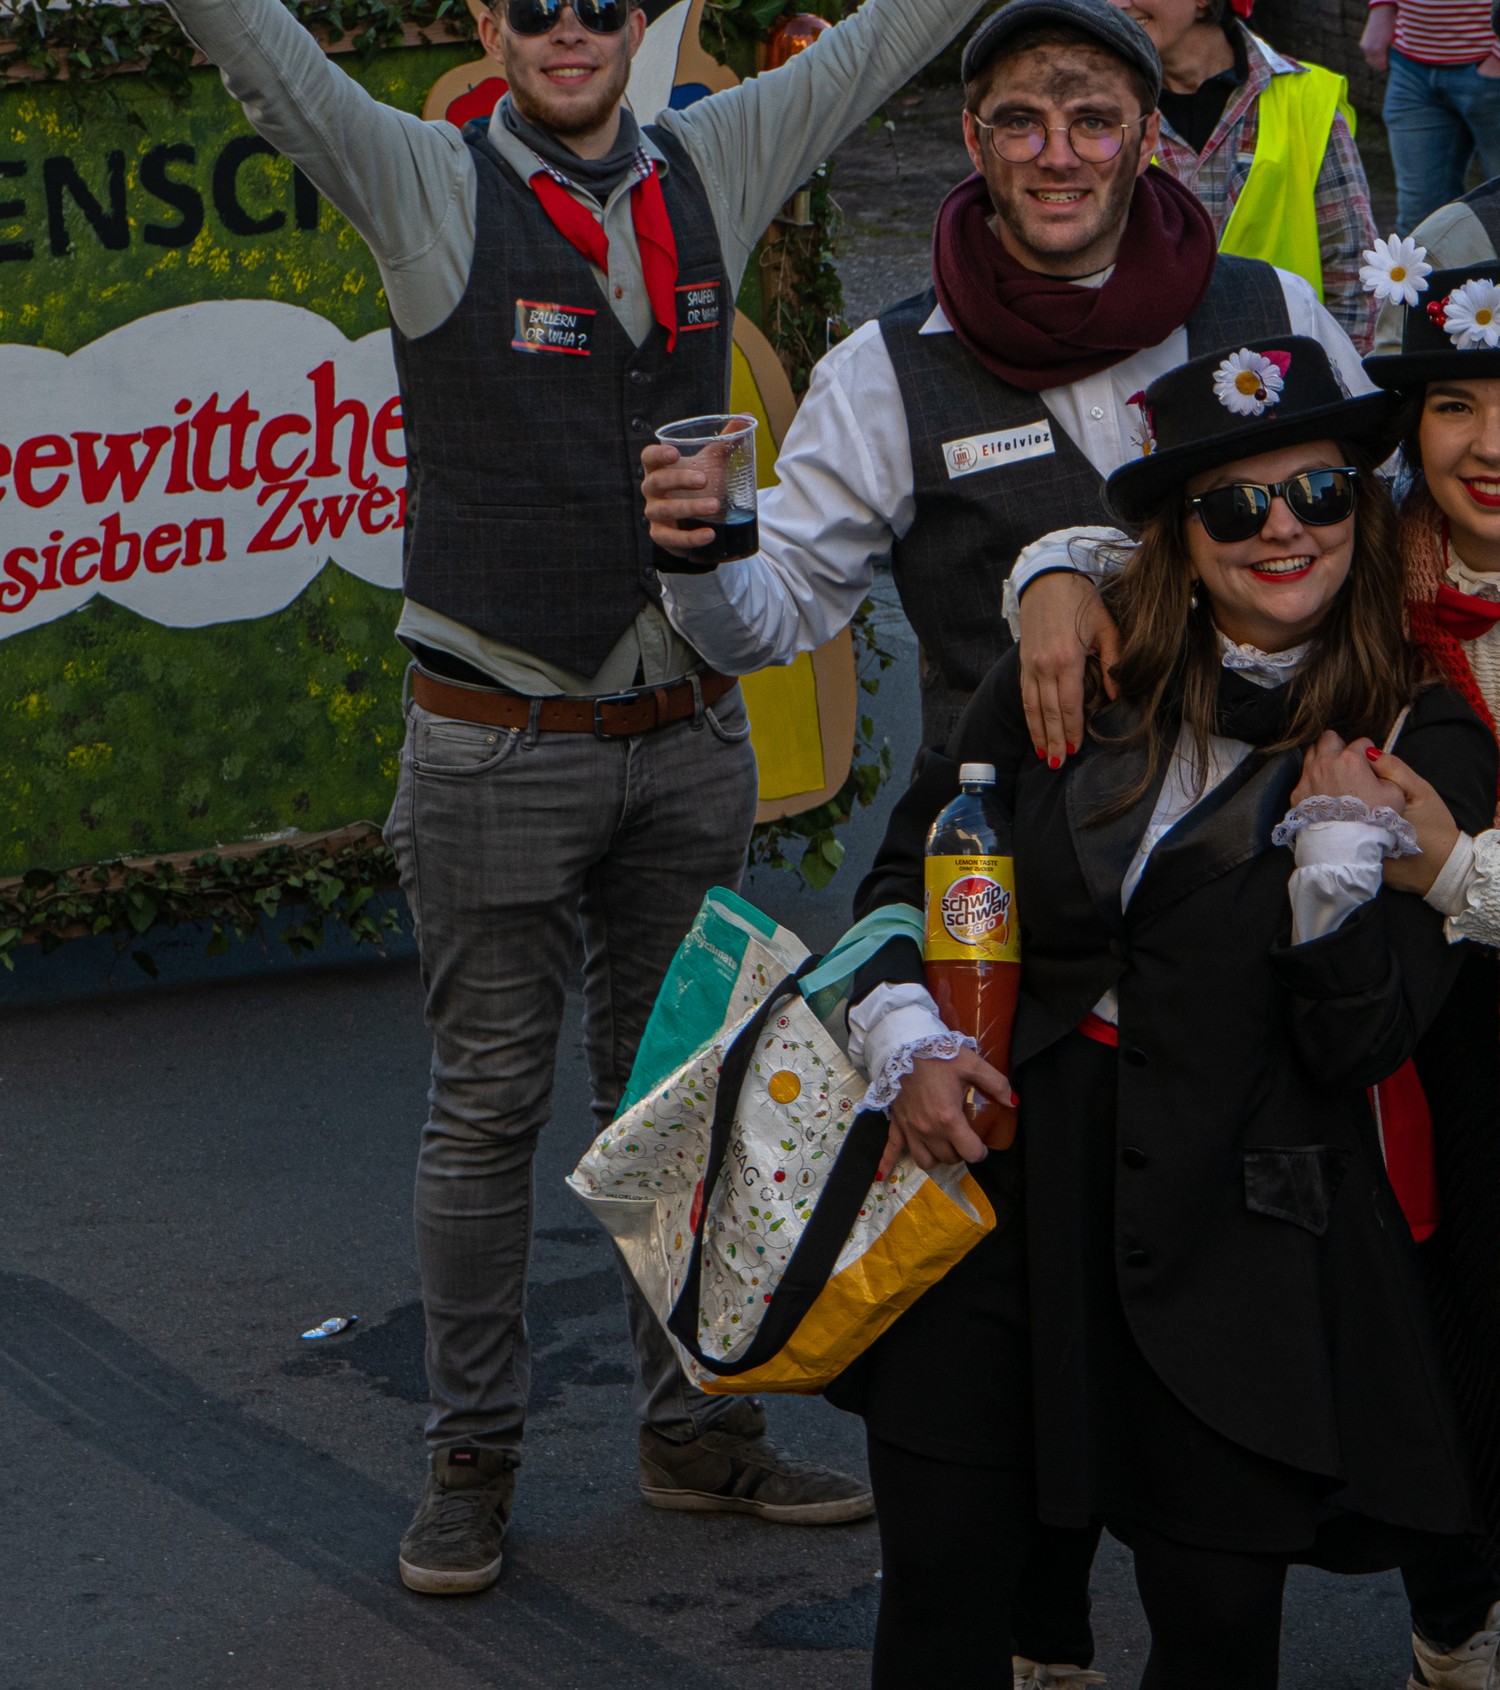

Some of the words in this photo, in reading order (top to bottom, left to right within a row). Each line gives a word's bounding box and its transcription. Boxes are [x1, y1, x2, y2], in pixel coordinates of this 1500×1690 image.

[529, 310, 577, 328] BALLERN
[687, 309, 702, 324] OR
[525, 327, 546, 345] OR
[982, 432, 1050, 457] Eifelviez
[0, 511, 227, 614] sieben
[979, 859, 998, 867] TASTE
[941, 885, 1001, 912] schwip
[946, 891, 1011, 926] schwap
[966, 917, 996, 937] zero
[733, 1140, 760, 1187] BAG
